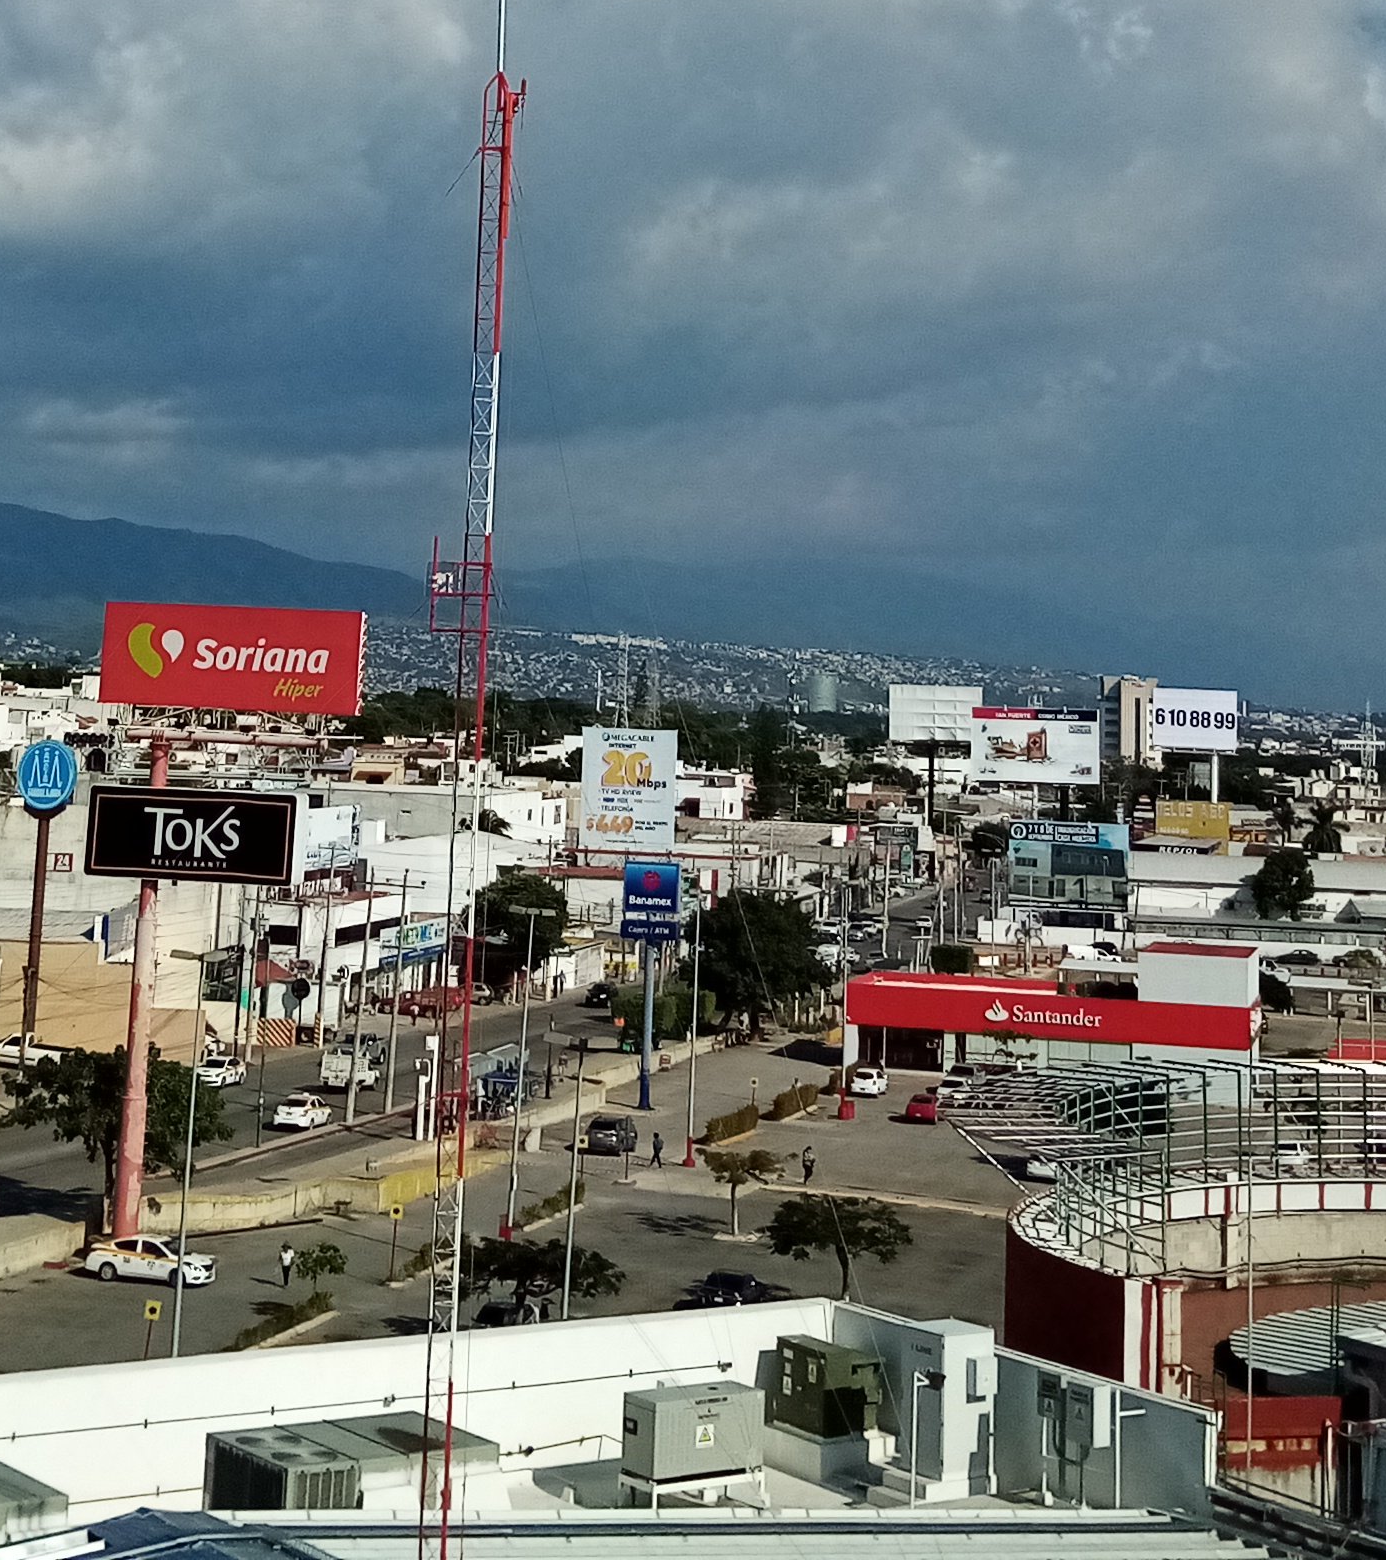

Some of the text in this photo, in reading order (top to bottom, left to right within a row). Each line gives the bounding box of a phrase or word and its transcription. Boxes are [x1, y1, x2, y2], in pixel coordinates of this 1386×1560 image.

[192, 637, 330, 674] Soriana
[611, 734, 655, 742] MEGACABLE
[601, 750, 667, 791] 20 Mbps
[1159, 845, 1198, 855] REPSOL
[150, 858, 227, 868] RESTAURANTE
[628, 894, 672, 907] Banamex
[1012, 1004, 1103, 1027] Santander
